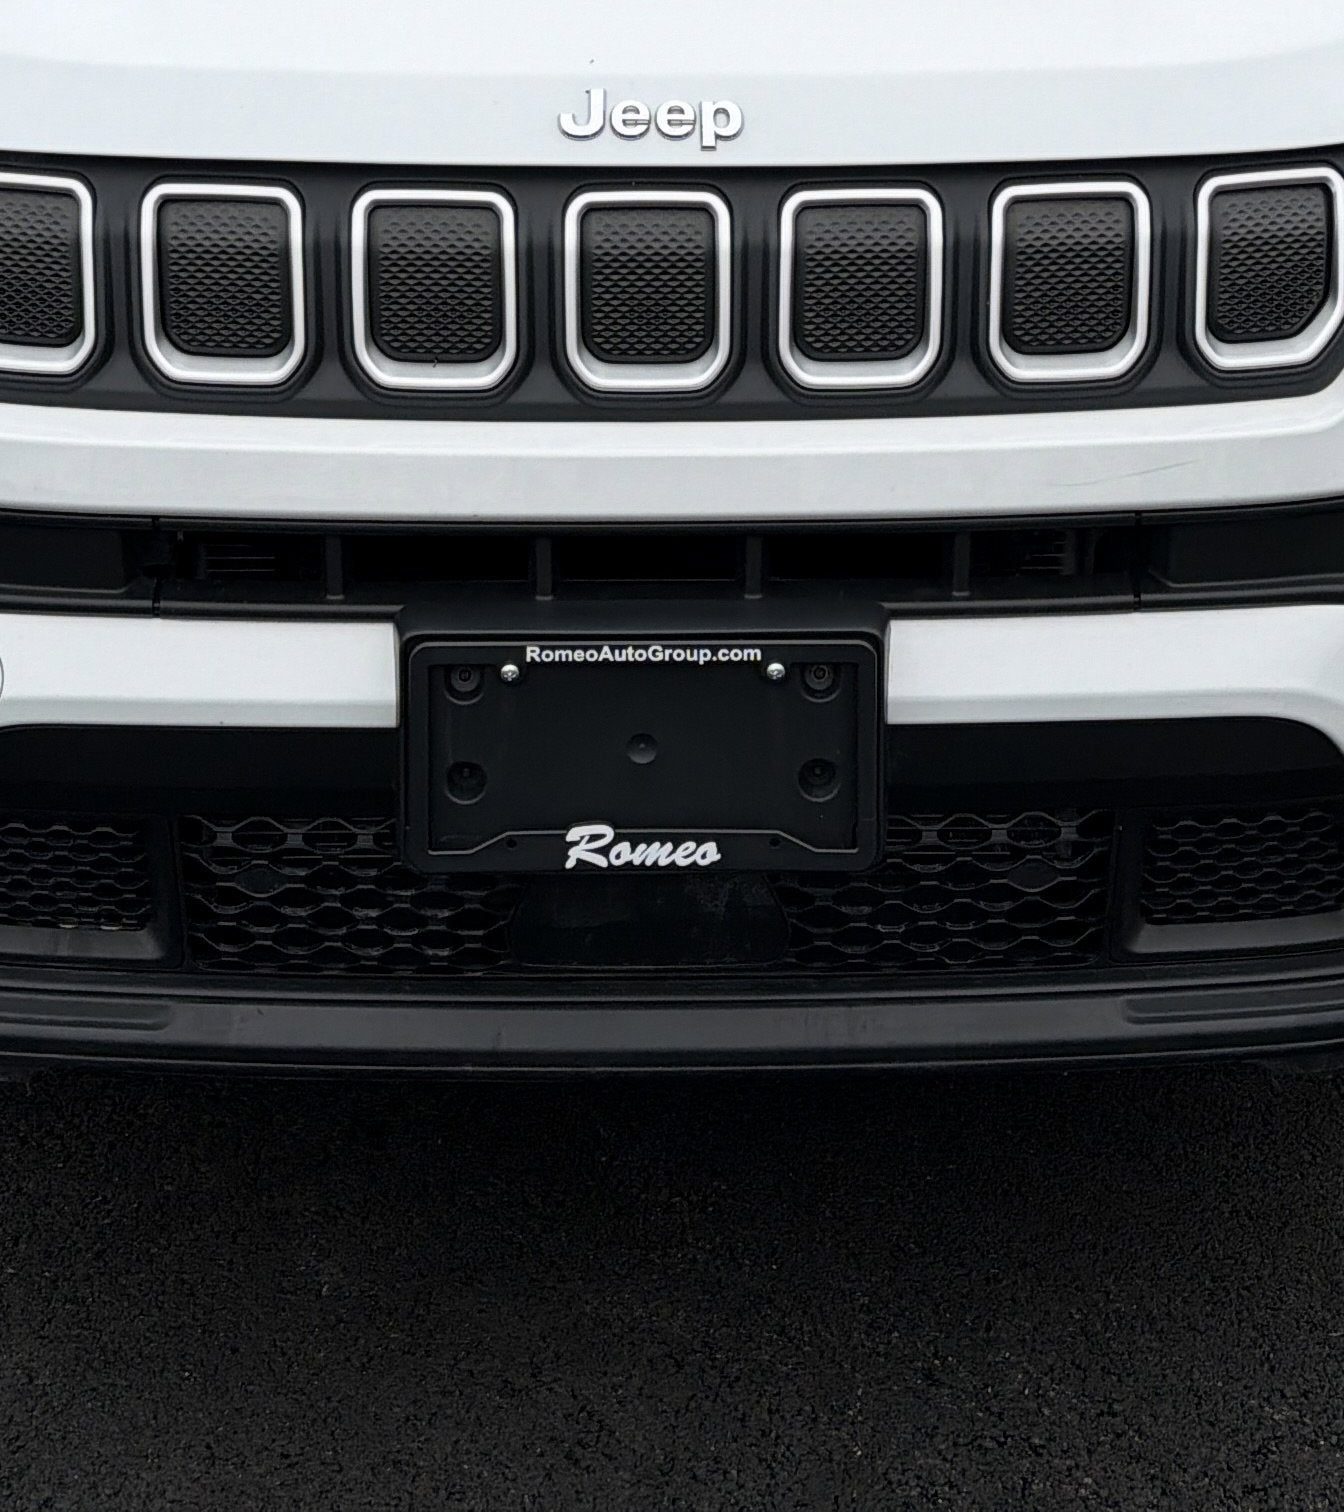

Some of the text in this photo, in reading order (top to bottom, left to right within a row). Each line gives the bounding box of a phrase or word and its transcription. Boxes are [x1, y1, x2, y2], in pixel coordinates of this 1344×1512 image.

[558, 88, 744, 150] Jeep
[525, 645, 762, 665] RomeoAutoGroup.com
[564, 824, 722, 869] Romeo
